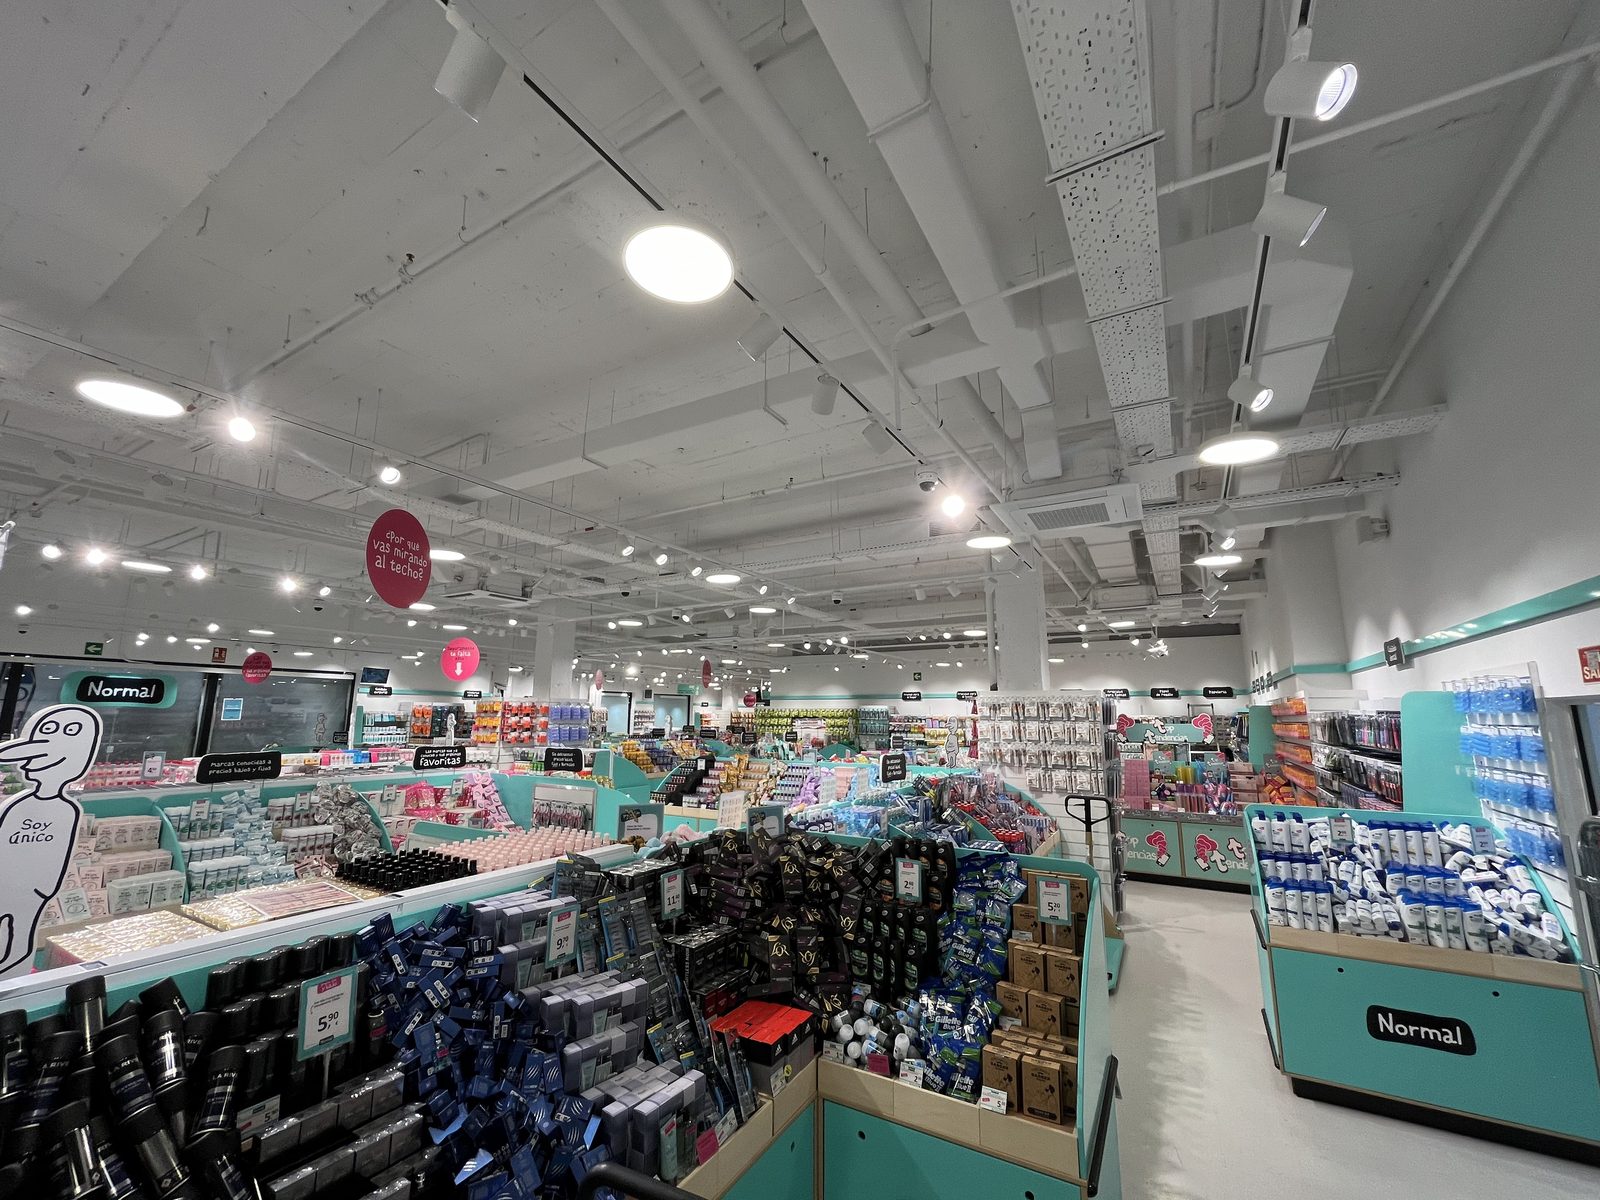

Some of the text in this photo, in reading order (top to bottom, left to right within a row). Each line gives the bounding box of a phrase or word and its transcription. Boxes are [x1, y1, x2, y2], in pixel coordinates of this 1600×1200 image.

[373, 540, 428, 568] vas mirando
[375, 555, 424, 582] al techo?
[87, 680, 156, 698] Normal
[420, 756, 461, 767] favoritas
[21, 818, 52, 832] Soy
[9, 831, 54, 845] único
[951, 942, 976, 956] Gillette
[317, 1011, 339, 1032] 5,90
[935, 1015, 962, 1026] Gillette
